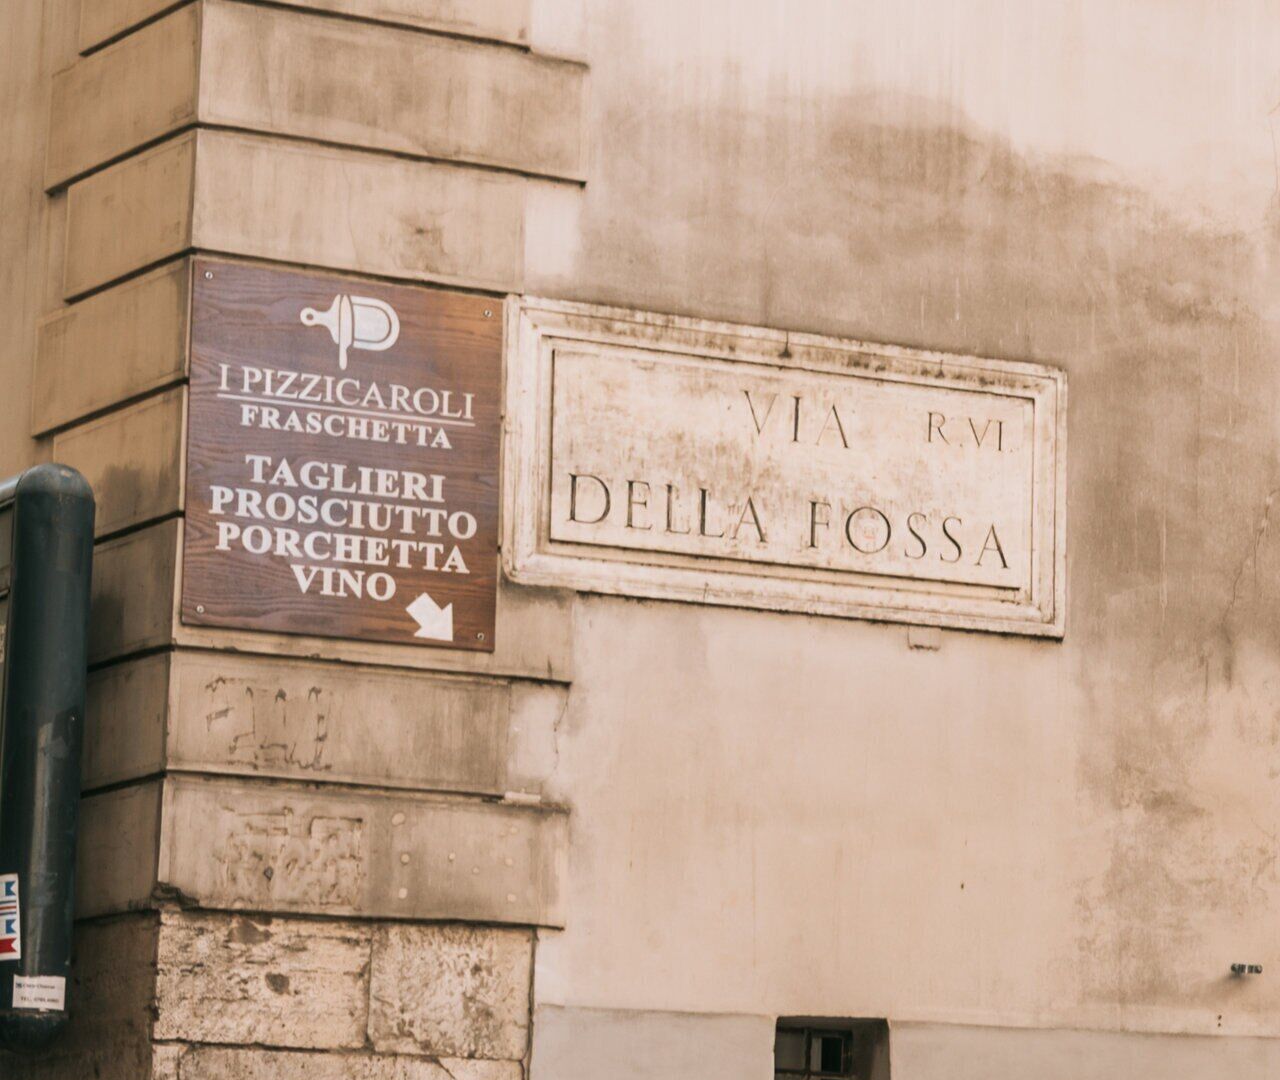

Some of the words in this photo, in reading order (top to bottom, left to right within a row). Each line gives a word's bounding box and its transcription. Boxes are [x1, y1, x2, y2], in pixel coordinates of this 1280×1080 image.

[219, 364, 233, 391] I
[240, 366, 476, 420] PIZZICAROLI
[743, 389, 849, 449] VIA
[240, 404, 453, 449] FRASCHETTA
[245, 454, 446, 502] TAGLIERI
[208, 485, 478, 540] PROSCIUTTO
[568, 472, 768, 544] DELLA
[808, 500, 1011, 569] FOSSA
[214, 522, 470, 575] PORCHETTA
[291, 564, 397, 601] VINO
